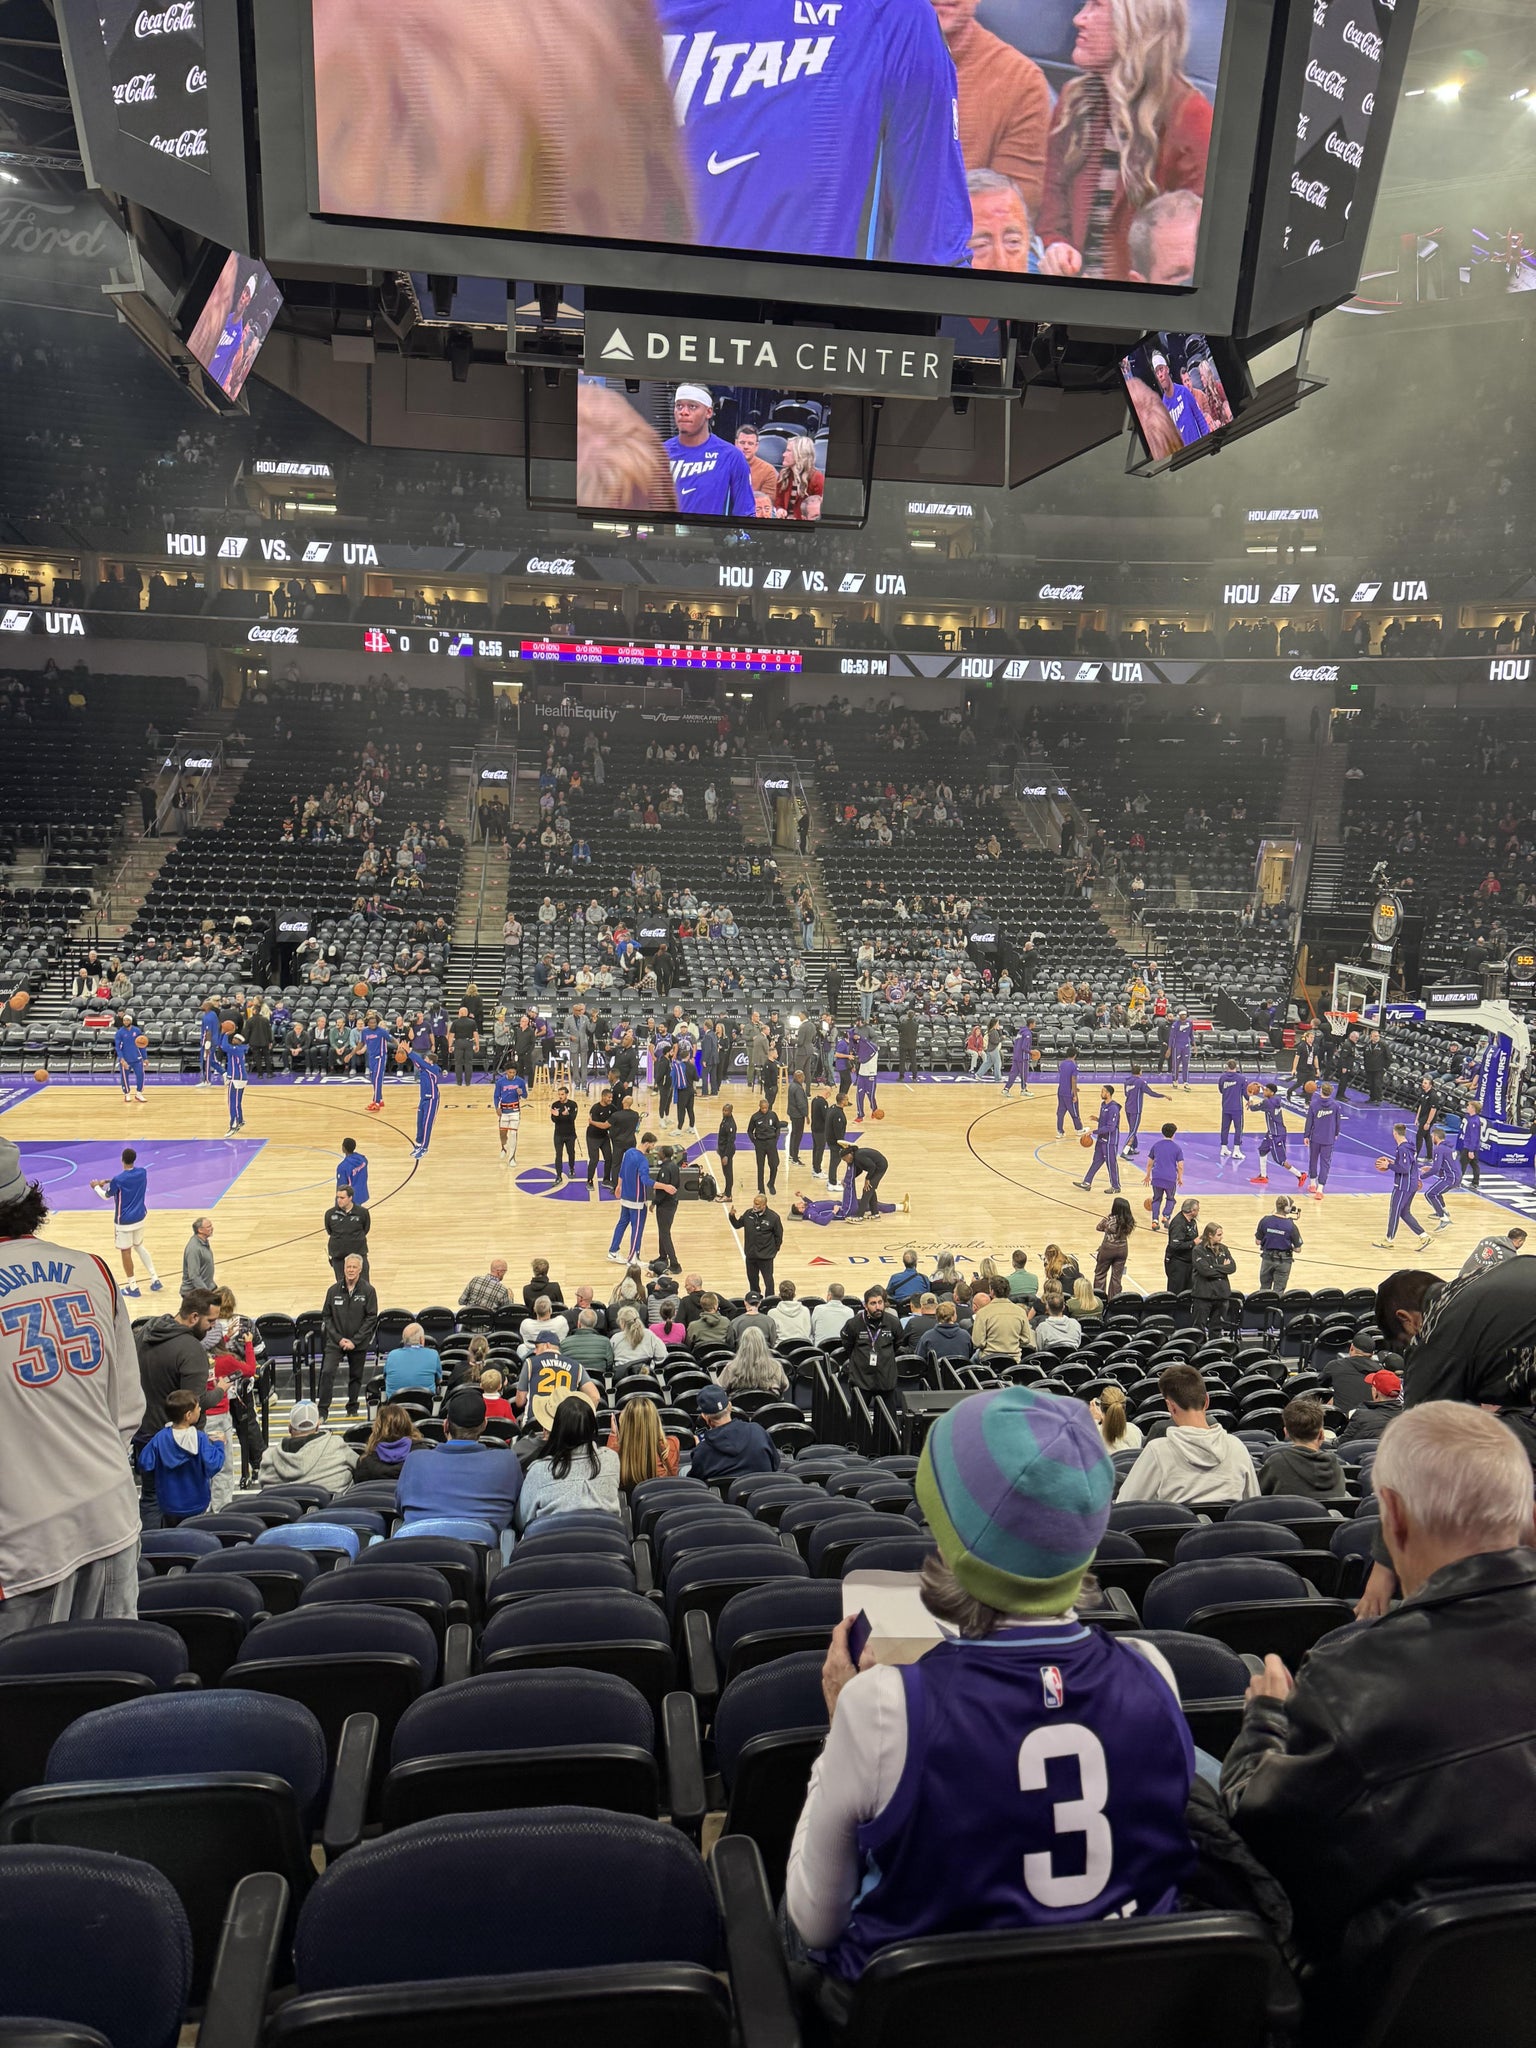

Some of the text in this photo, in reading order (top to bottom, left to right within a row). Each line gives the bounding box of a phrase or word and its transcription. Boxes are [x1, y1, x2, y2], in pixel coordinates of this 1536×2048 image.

[134, 1, 196, 38] Coca-Cola
[1343, 20, 1383, 62] Coca-Cola
[1305, 59, 1347, 101] Coca-Cola
[647, 332, 939, 378] DELTA CENTER
[256, 461, 276, 473] HOU
[312, 465, 330, 476] UTA
[909, 502, 926, 514] HOU
[957, 505, 973, 516] UTA
[1248, 510, 1266, 522] HOU
[1301, 509, 1319, 520] UTA
[167, 533, 379, 566] HOU VS. UTA
[527, 557, 576, 576] Coca-Cola
[719, 565, 907, 596] HOU VS. UTA
[1039, 583, 1085, 601] Coca-Cola
[1223, 580, 1428, 604] HOU VS. UTA
[45, 611, 85, 636] UTA
[248, 625, 299, 644] Coca-Cola
[400, 636, 503, 657] 0 0 9:55
[508, 650, 519, 658] 1ST
[841, 658, 888, 676] 06:53 PM
[960, 658, 1143, 682] HOU VS. UTA
[1289, 665, 1340, 681] Coca-Cola
[1489, 660, 1530, 681] HOU
[535, 704, 617, 722] HealthEquity
[1380, 904, 1395, 918] 9:55
[1517, 956, 1534, 965] 9:55
[1479, 1047, 1495, 1104] MERICA FIRST
[1495, 1051, 1508, 1115] AMERICA FIRST
[0, 1288, 105, 1389] 35
[540, 1359, 572, 1371] HAYWARD
[537, 1367, 572, 1393] 20
[1018, 1722, 1113, 1908] 3
